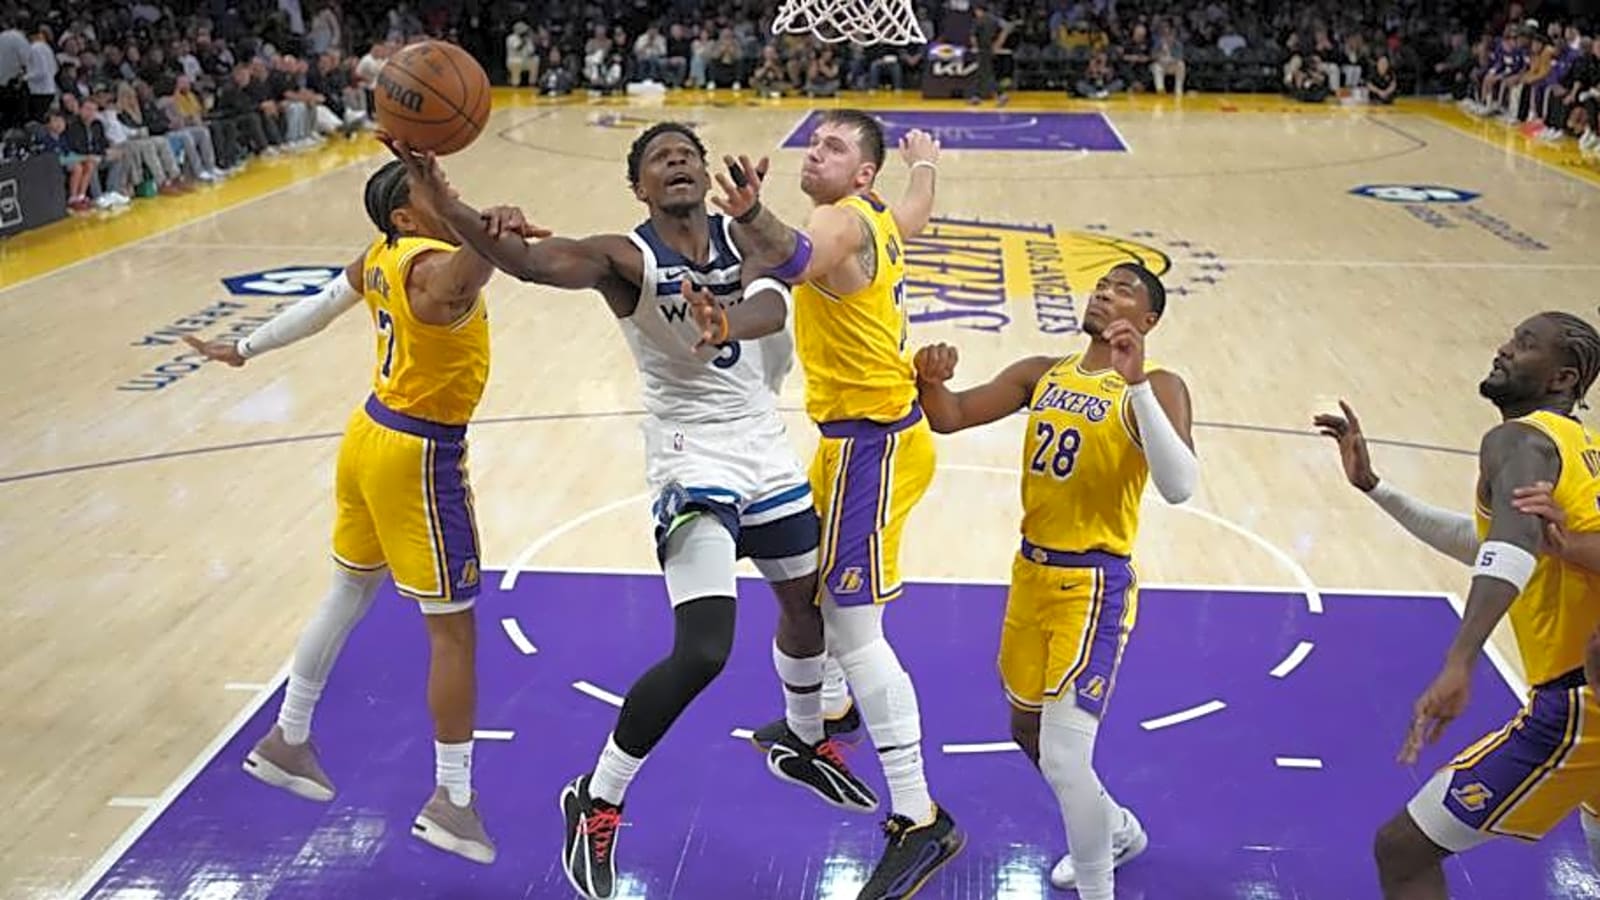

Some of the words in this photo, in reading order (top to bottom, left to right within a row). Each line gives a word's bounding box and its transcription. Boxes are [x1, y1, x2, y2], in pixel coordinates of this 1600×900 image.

[377, 308, 396, 380] 7
[1032, 381, 1112, 423] LAKERS
[1030, 420, 1082, 478] 28
[1480, 551, 1497, 567] 5
